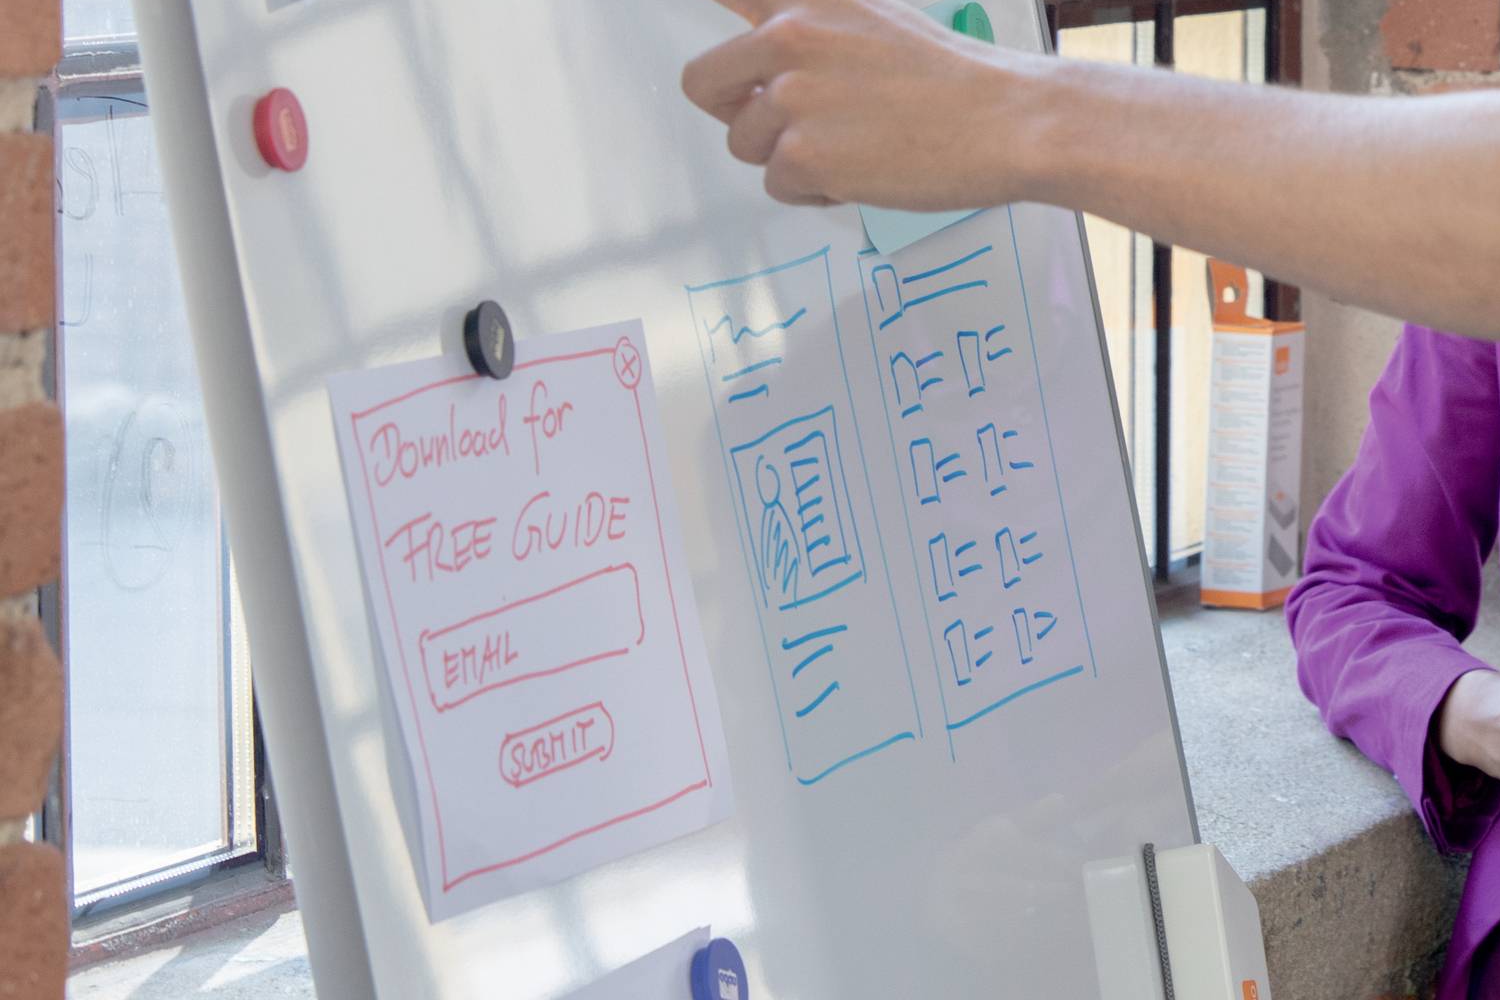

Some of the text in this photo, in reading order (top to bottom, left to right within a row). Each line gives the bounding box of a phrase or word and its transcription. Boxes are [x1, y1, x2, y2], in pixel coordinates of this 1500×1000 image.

[370, 379, 574, 487] Download for
[385, 490, 631, 583] FREE GUIDE
[442, 631, 519, 688] EMAIL
[509, 717, 596, 781] SUBMIT
